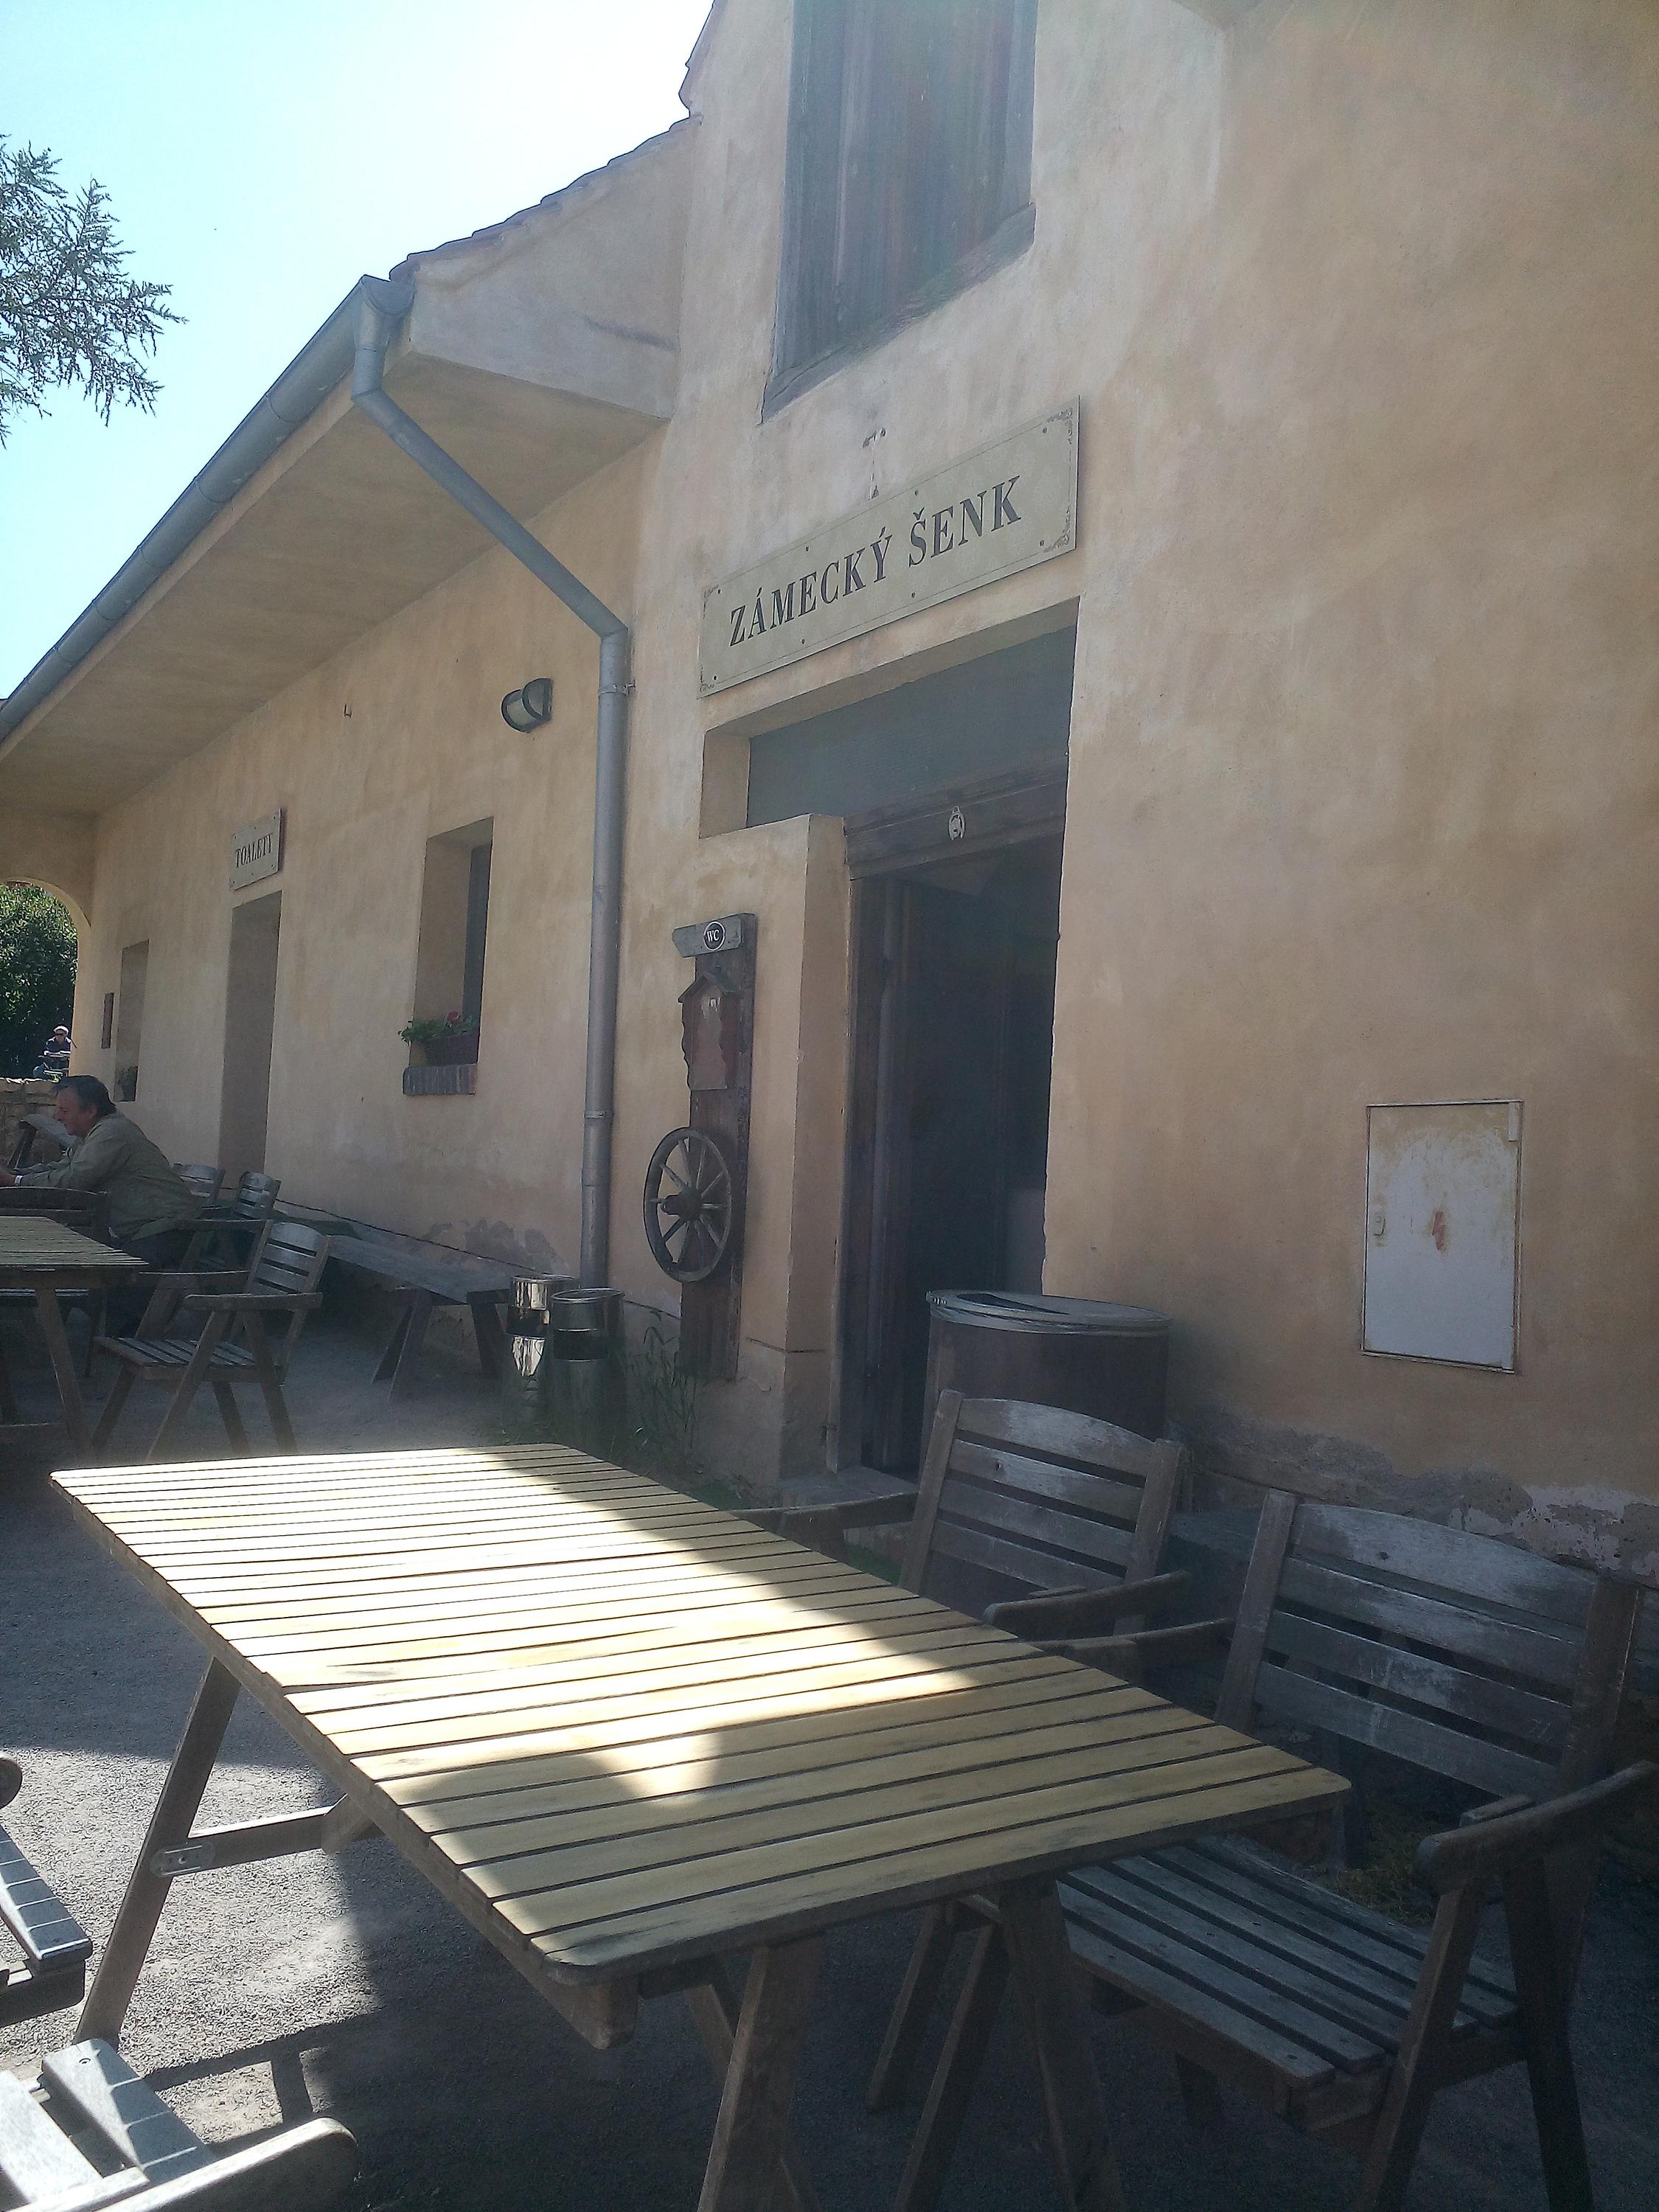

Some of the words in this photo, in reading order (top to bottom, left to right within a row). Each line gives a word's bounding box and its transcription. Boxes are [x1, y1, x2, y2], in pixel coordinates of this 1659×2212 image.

[729, 526, 892, 647] ZÁMECKÝ
[908, 475, 1022, 567] ŠENK
[236, 832, 274, 868] TOALETY
[706, 929, 720, 942] WC
